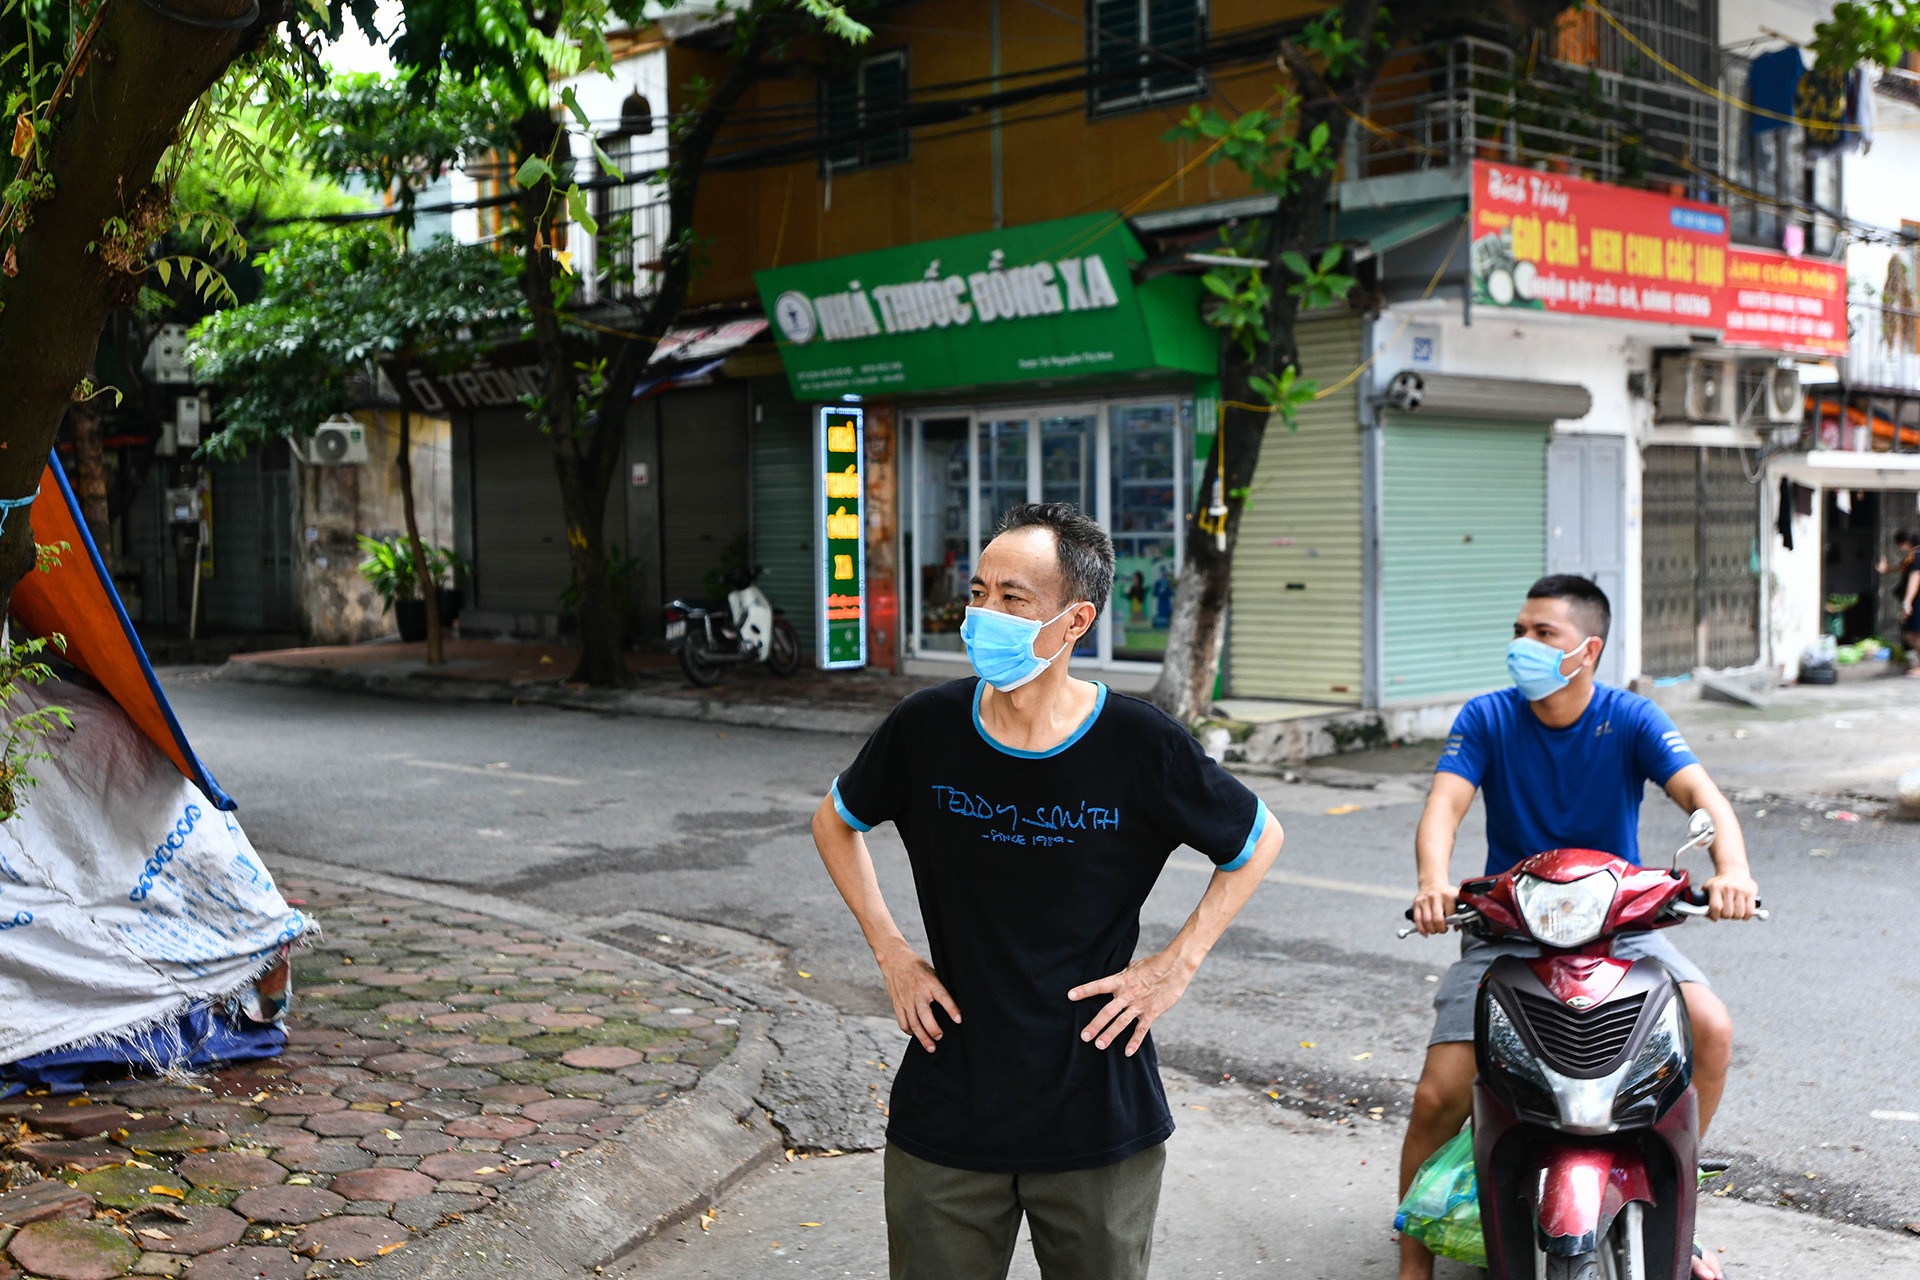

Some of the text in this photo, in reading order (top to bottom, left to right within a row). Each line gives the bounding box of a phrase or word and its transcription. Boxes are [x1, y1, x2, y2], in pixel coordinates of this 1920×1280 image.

[1590, 227, 1623, 274] NEM
[1666, 235, 1694, 284] CÁC
[814, 248, 1119, 342] NHÀ THUỐC ĐỒNG XA
[931, 785, 1019, 831] TEDDY
